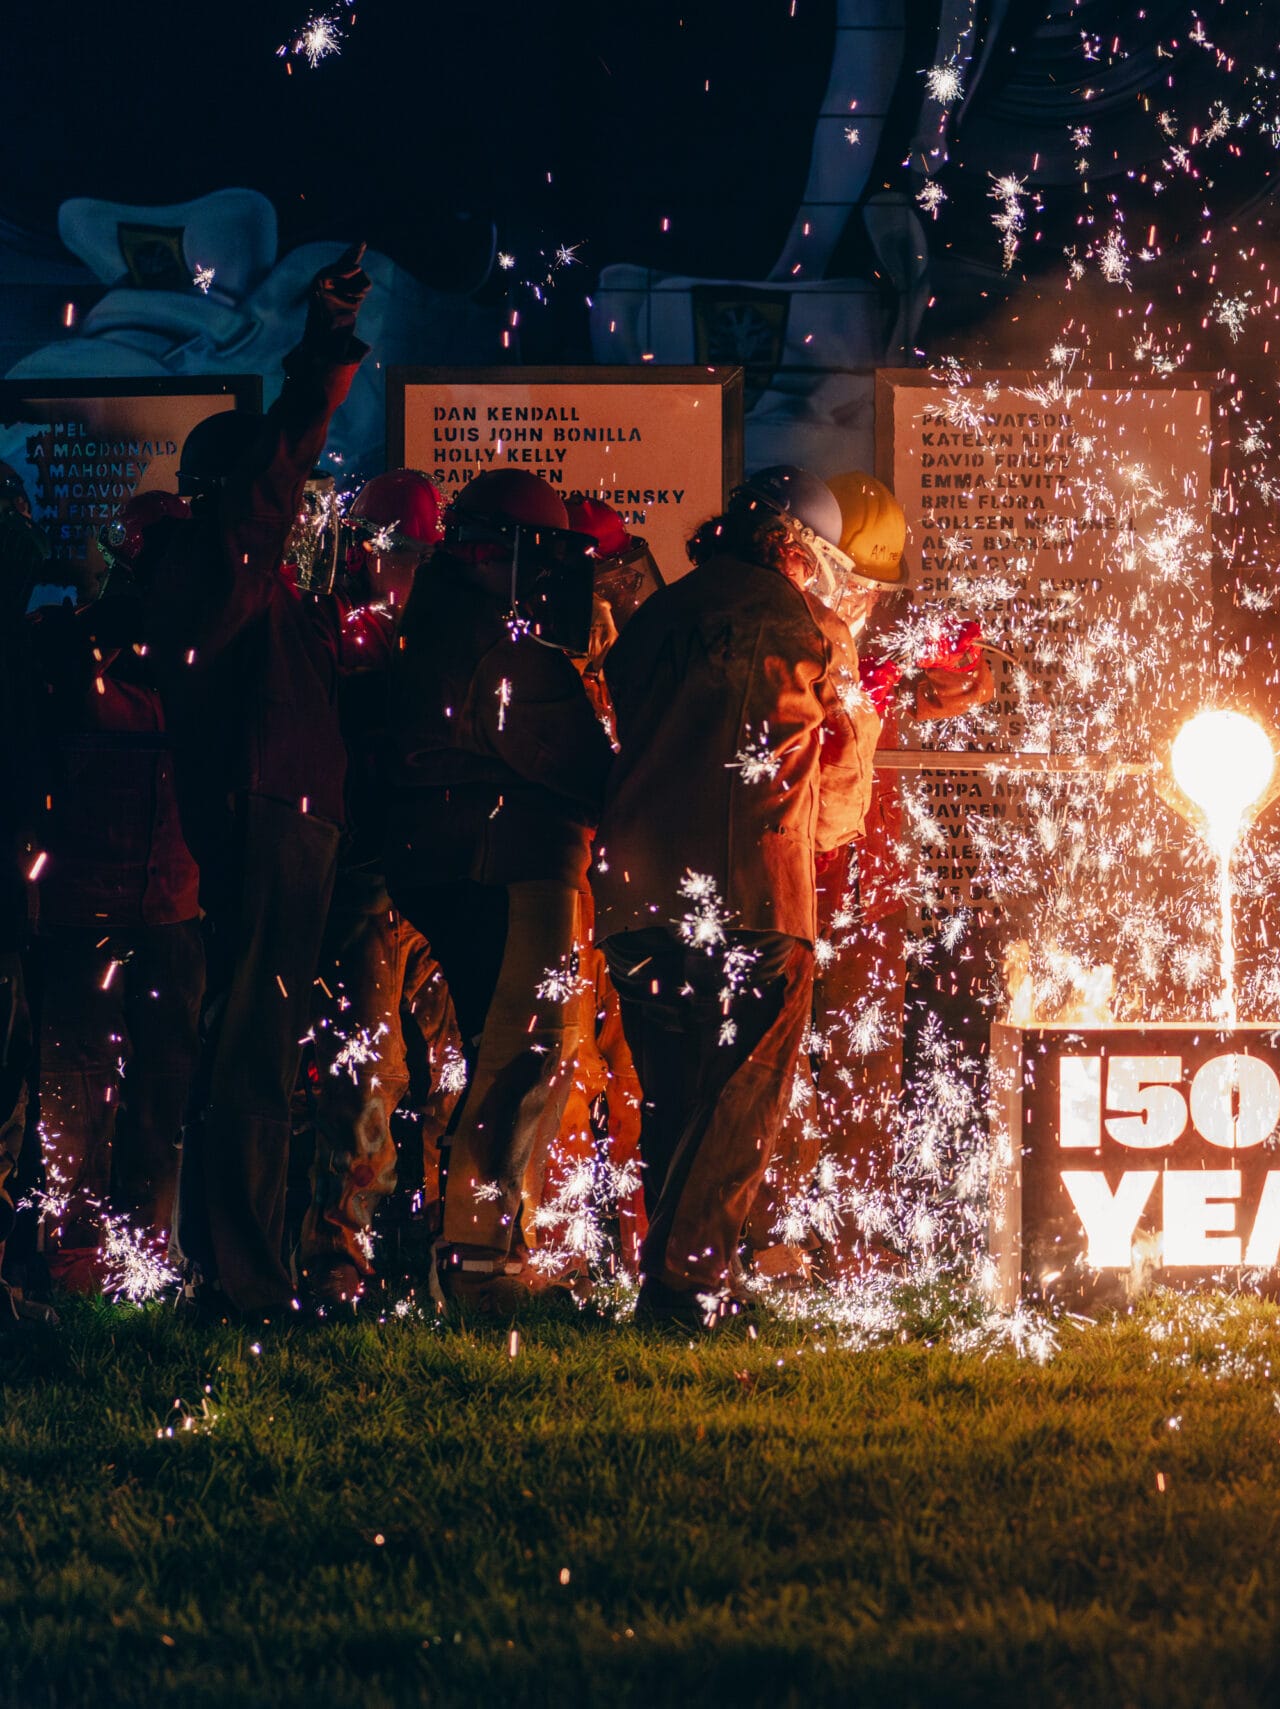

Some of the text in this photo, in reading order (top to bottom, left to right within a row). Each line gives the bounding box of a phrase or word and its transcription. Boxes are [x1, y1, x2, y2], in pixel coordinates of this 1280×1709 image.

[434, 407, 580, 421] DAN KENDALL
[434, 427, 642, 442] LUIS JOHN BONILLA
[921, 432, 1013, 447] KATELYN
[434, 448, 567, 463] HOLLY KELLY
[921, 453, 984, 467] DAVID
[50, 462, 149, 478] MAHONEY
[921, 473, 1067, 488] EMMA LEVITZ
[921, 495, 1046, 509] BRIE FLORA
[921, 515, 1014, 530] COLLEEN
[921, 556, 978, 571] EVAN
